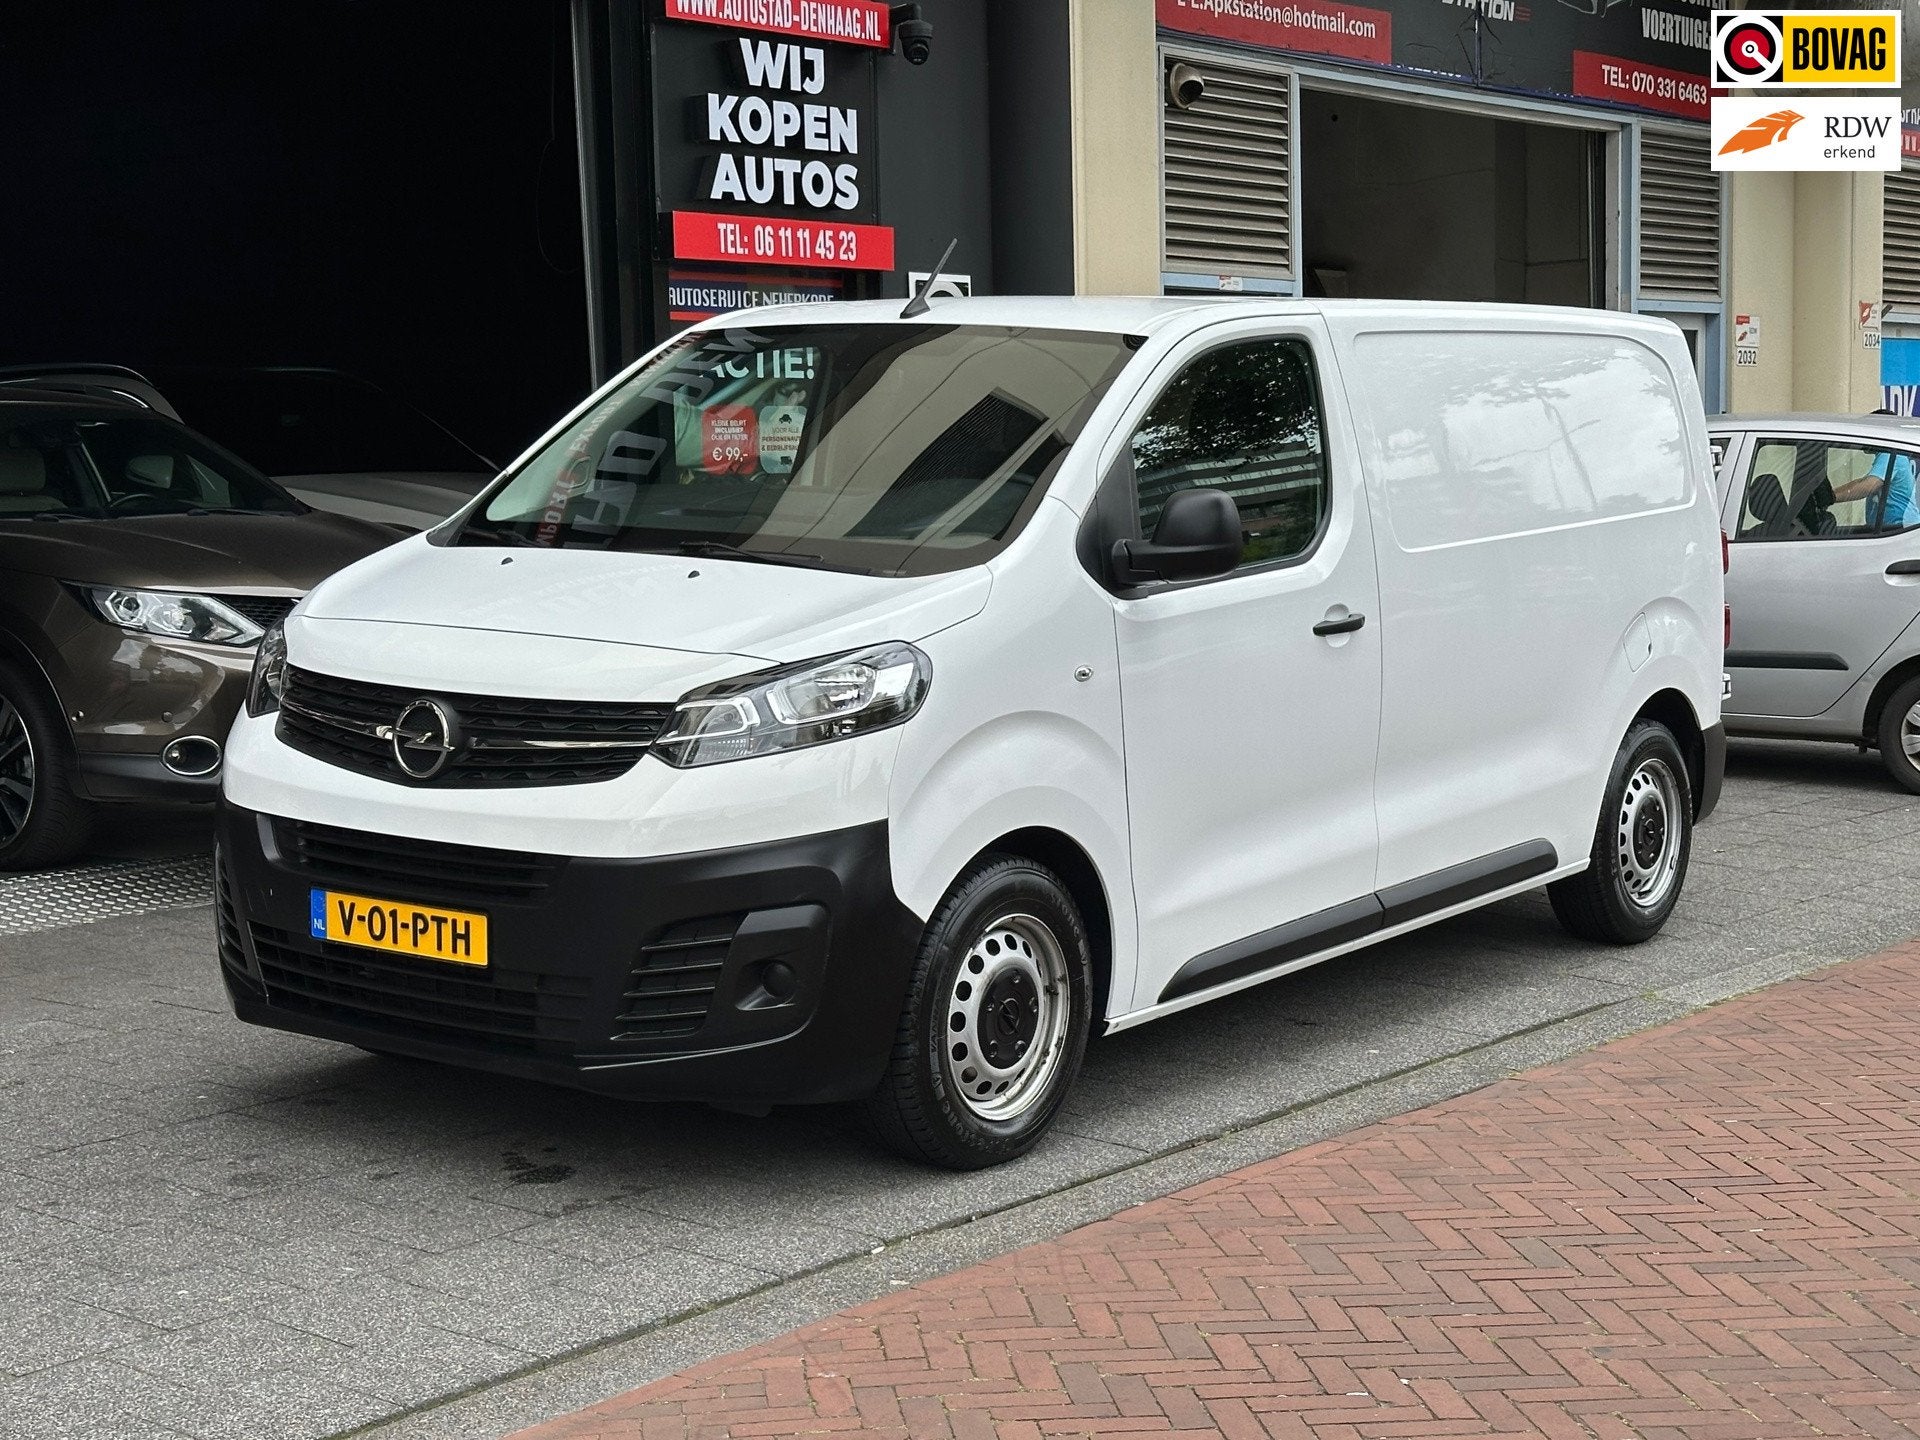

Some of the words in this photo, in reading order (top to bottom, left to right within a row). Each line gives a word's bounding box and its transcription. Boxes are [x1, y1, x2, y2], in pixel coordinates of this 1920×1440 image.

[1641, 7, 1711, 50] VOERTUIGE
[739, 37, 825, 95] WIJ
[1601, 64, 1629, 89] TEL:
[1632, 71, 1655, 95] 070
[1657, 77, 1675, 99] 331
[1678, 82, 1707, 105] 6463
[707, 92, 858, 154] KOPEN
[709, 153, 859, 210] AUTOS
[717, 222, 749, 255] TEL:
[754, 224, 774, 257] 06
[778, 226, 793, 258] 11
[797, 228, 811, 258] 11
[815, 229, 834, 260] 45
[839, 230, 857, 262] 23
[1738, 350, 1757, 364] 2032
[712, 447, 723, 461] €
[338, 900, 471, 956] V-01-PTH
